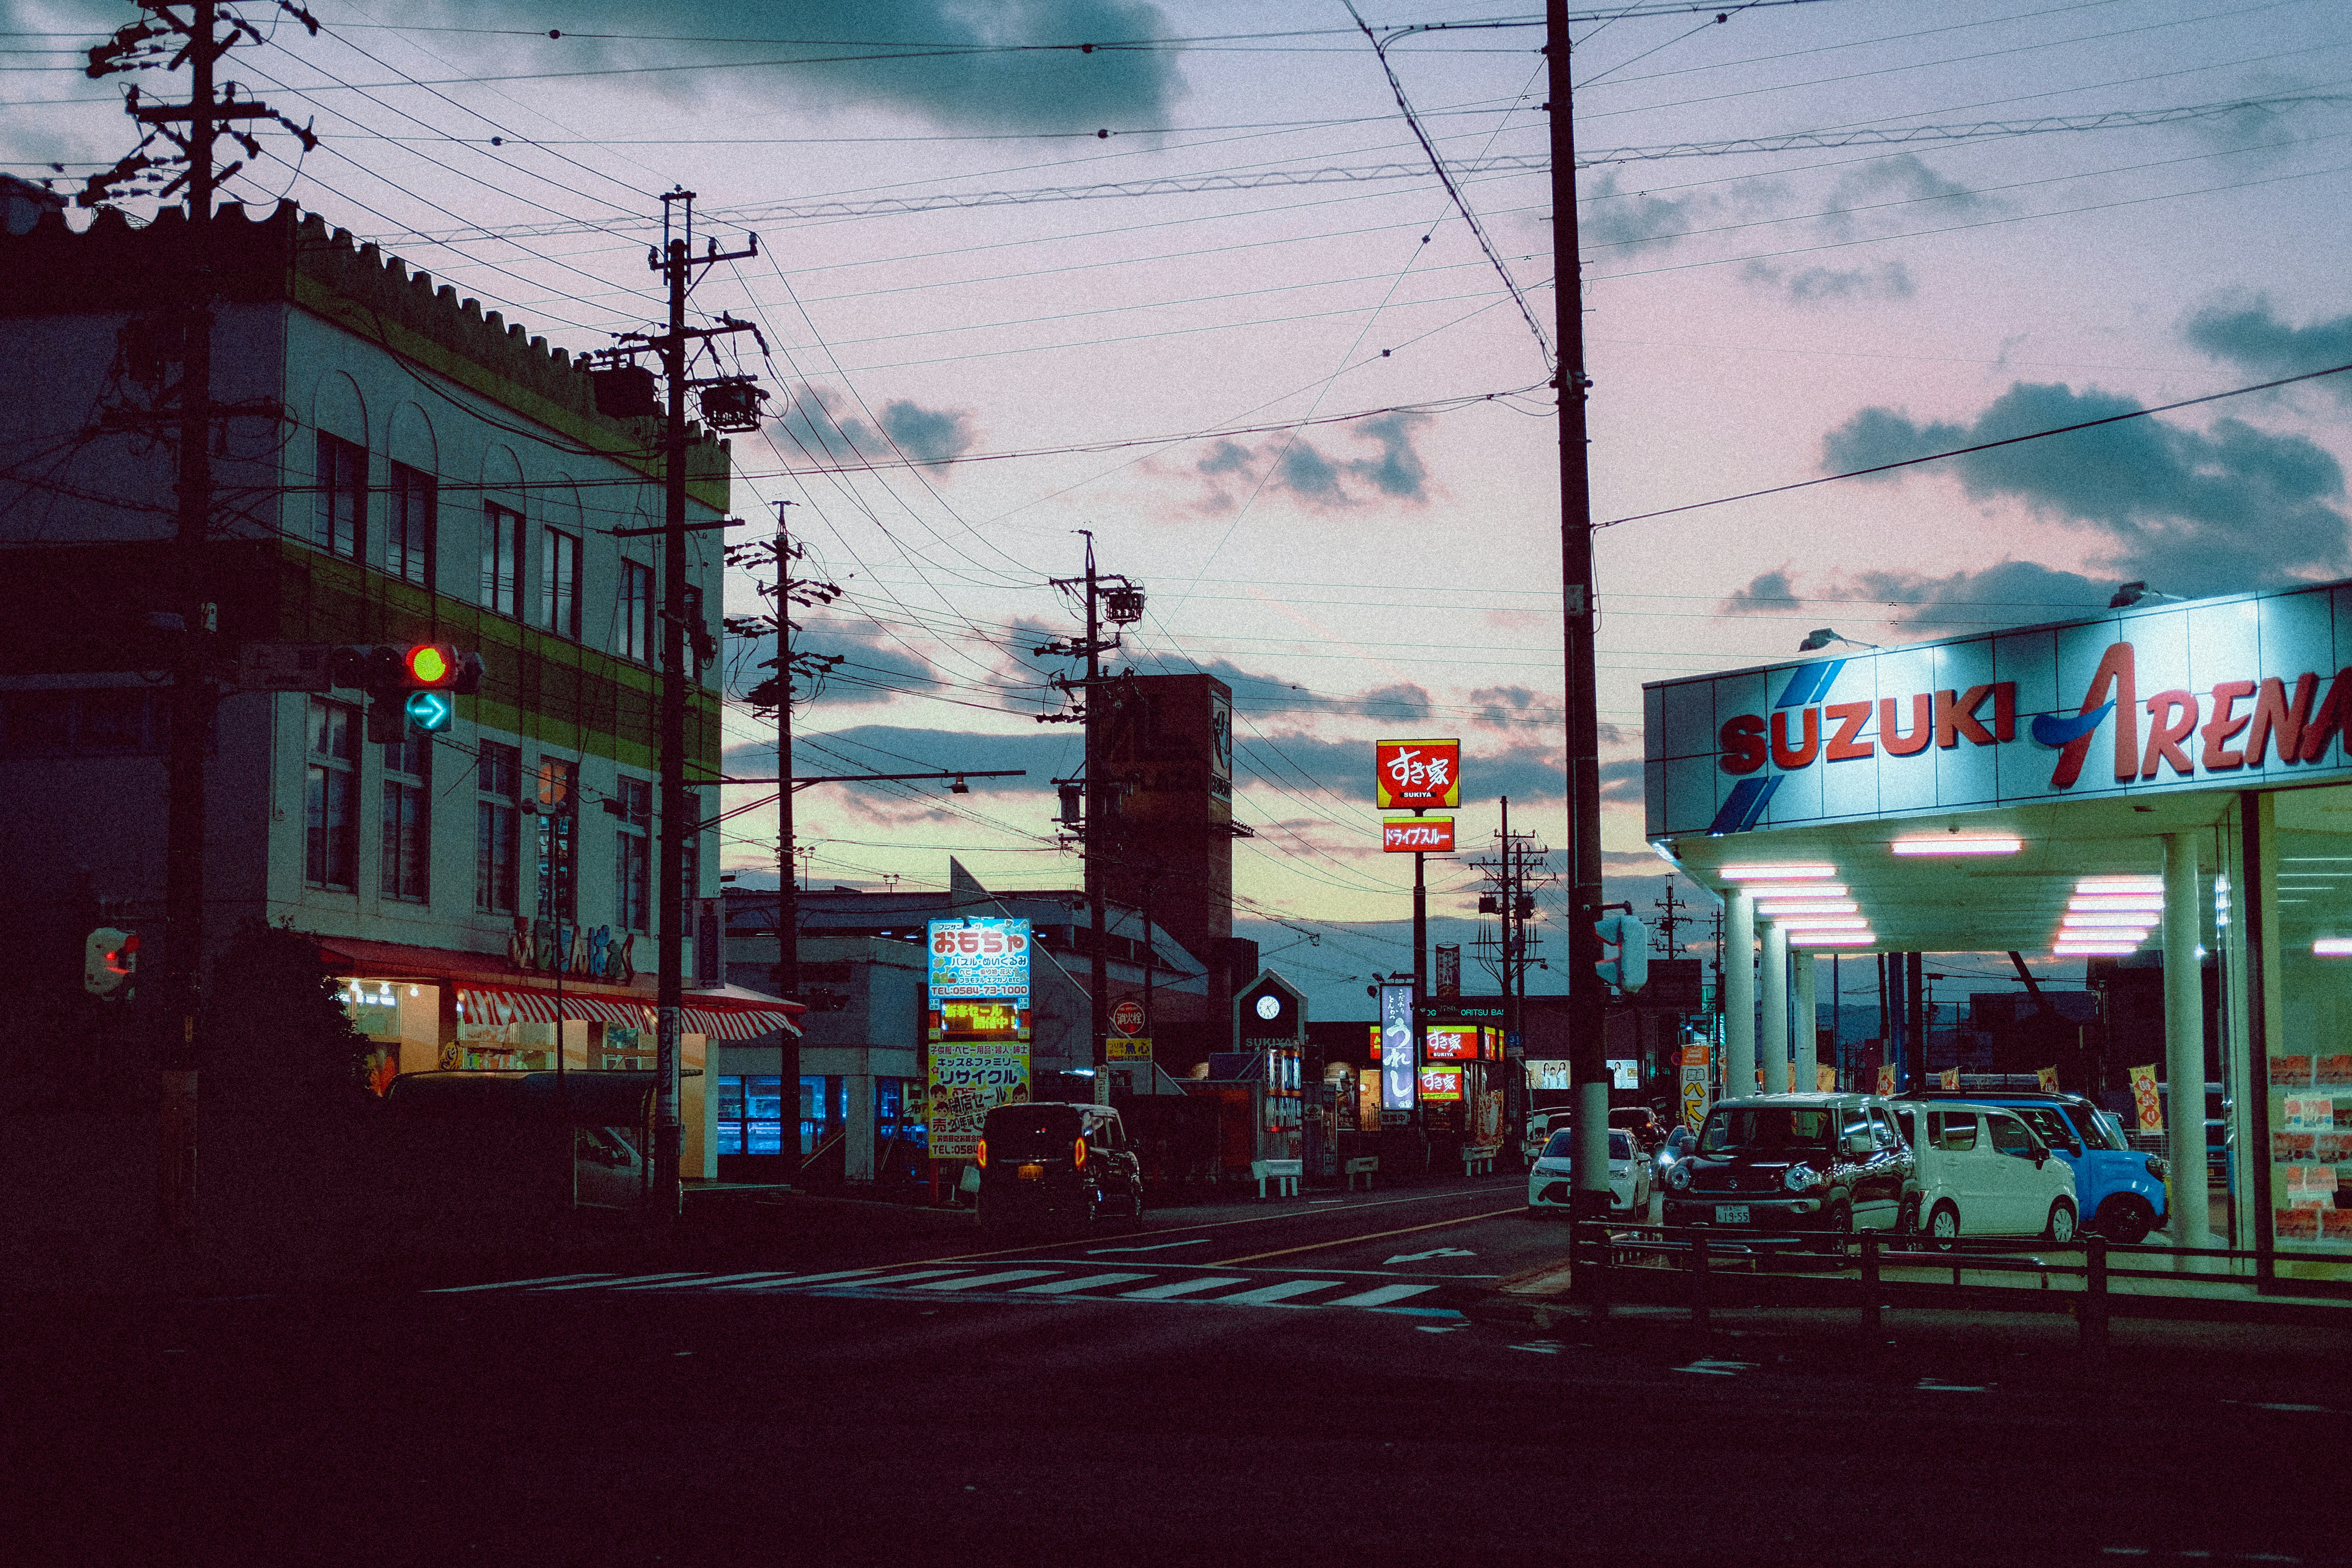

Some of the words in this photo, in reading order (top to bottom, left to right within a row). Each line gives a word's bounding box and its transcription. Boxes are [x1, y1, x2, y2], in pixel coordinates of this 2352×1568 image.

[1718, 680, 2017, 775] SUZUKI
[1387, 747, 1448, 791] すき家
[1386, 827, 1450, 846] ドライブスルー
[934, 931, 1024, 953] おもちゃ
[931, 986, 1027, 995] TEL:0584-73-1000
[1117, 1012, 1143, 1025] 消火栓
[1427, 1028, 1461, 1052] すき家
[1383, 1017, 1413, 1098] うれし
[940, 1070, 1018, 1085] リサイクル
[1421, 1069, 1455, 1093] すき家
[948, 1086, 1008, 1115] 閉店セール
